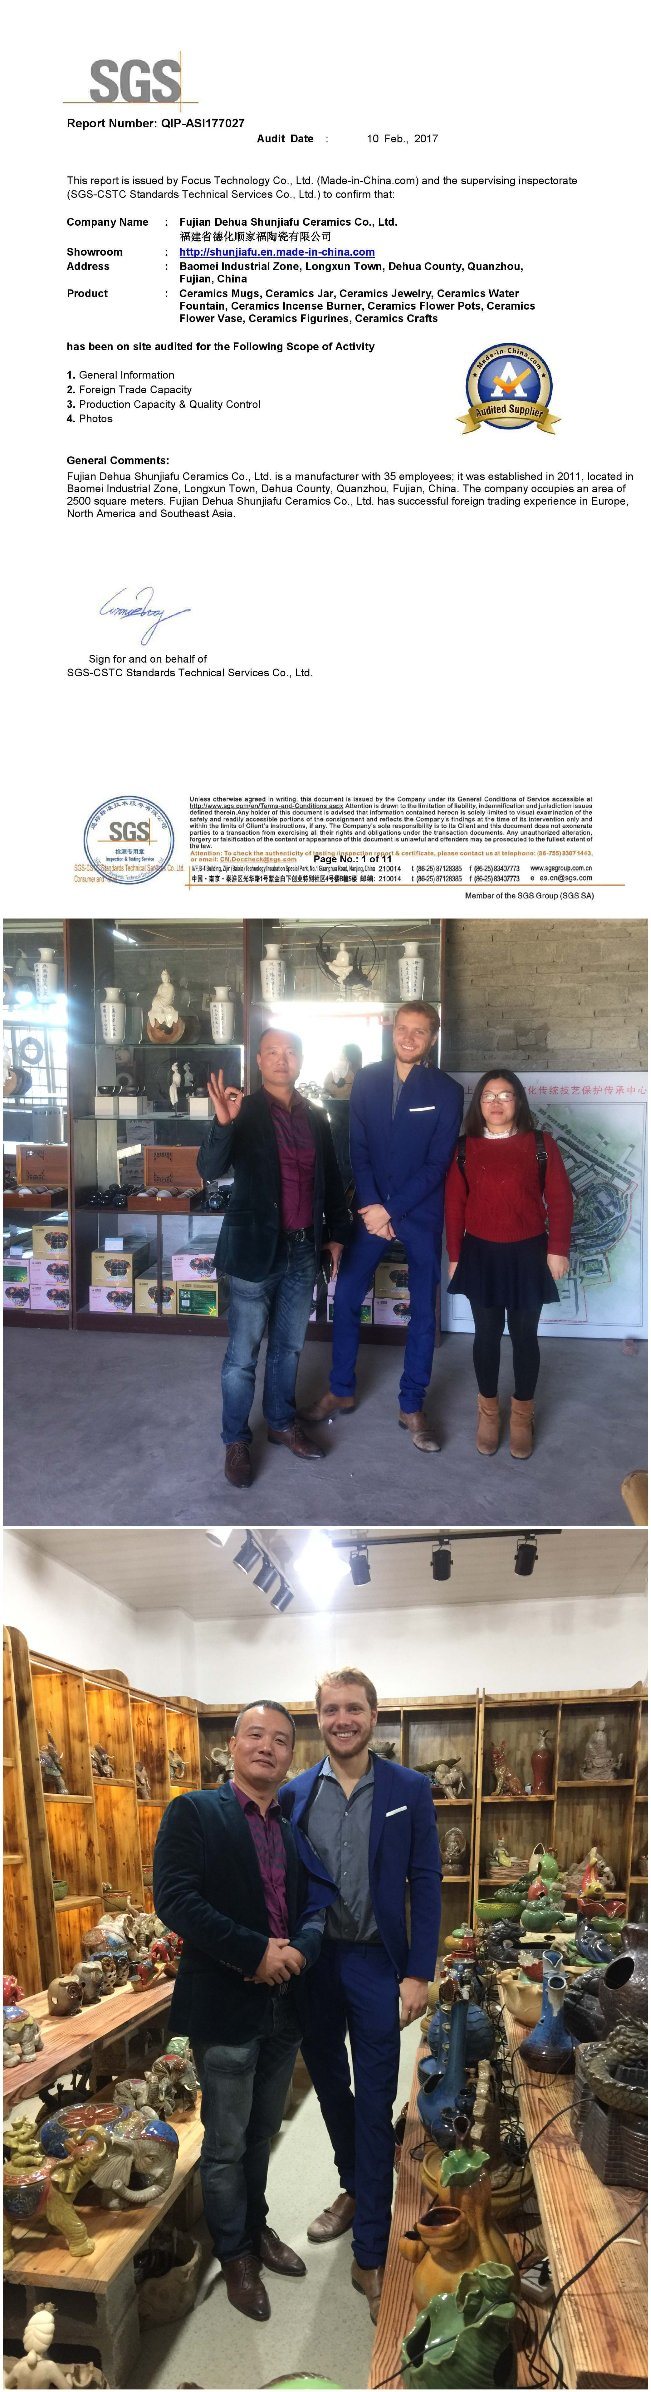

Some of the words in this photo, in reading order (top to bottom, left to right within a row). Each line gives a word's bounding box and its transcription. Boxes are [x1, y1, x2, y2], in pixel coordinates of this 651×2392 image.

[90, 59, 181, 104] SGS
[68, 119, 105, 130] Report
[109, 119, 156, 127] Number:
[162, 119, 244, 128] QIP-ASI177027
[257, 134, 285, 142] Audit
[291, 134, 313, 142] Date
[368, 134, 378, 142] 10
[385, 134, 408, 144] Feb.,
[415, 134, 438, 142] 2017
[67, 176, 87, 184] This
[91, 177, 119, 186] report
[122, 176, 129, 184] is
[133, 176, 163, 184] issued
[167, 176, 178, 186] by
[182, 176, 211, 184] Focus
[214, 176, 269, 186] Technology
[273, 176, 292, 185] Co.,
[297, 176, 313, 184] Ltd.
[317, 176, 418, 186] (Made-in-China.com)
[422, 176, 439, 184] and
[443, 176, 457, 184] the
[461, 176, 515, 186] supervising
[519, 176, 577, 186] inspectorate
[67, 190, 126, 200] (SGS-CSTC
[130, 190, 179, 198] Standards
[182, 190, 228, 198] Technical
[232, 190, 272, 198] Services
[276, 190, 295, 199] Co.,
[300, 190, 320, 200] Ltd.)
[336, 190, 370, 198] confirm
[374, 190, 394, 198] that:
[67, 218, 116, 228] Company
[120, 218, 148, 226] Name
[180, 218, 210, 228] Fujian
[215, 218, 247, 226] Dehua
[251, 218, 299, 228] Shunjiafu
[303, 218, 351, 226] Ceramics
[355, 218, 374, 227] Co.,
[379, 218, 397, 226] Ltd.
[180, 231, 331, 242] 福建省德化顺家福陶瓷有限公司
[67, 248, 122, 256] Showroom
[180, 248, 375, 258] http://shunjiafu.en.made-in-china.com
[67, 262, 109, 270] Address
[180, 262, 218, 270] Baomei
[222, 262, 269, 270] Industrial
[273, 262, 302, 272] Zone,
[306, 262, 350, 272] Longxun
[354, 262, 385, 272] Town,
[389, 262, 421, 270] Dehua
[425, 262, 464, 272] County,
[468, 262, 523, 272] Quanzhou,
[180, 275, 214, 285] Fujian,
[217, 275, 247, 283] China
[67, 289, 108, 297] Product
[180, 289, 228, 297] Ceramics
[232, 289, 262, 299] Mugs,
[266, 289, 314, 297] Ceramics
[318, 289, 336, 299] Jar,
[340, 289, 388, 297] Ceramics
[392, 289, 433, 299] Jewelry,
[437, 289, 485, 297] Ceramics
[489, 289, 519, 297] Water
[180, 302, 227, 311] Fountain,
[231, 302, 279, 310] Ceramics
[283, 302, 323, 310] Incense
[327, 302, 364, 311] Burner,
[368, 302, 416, 310] Ceramics
[420, 302, 455, 310] Flower
[458, 302, 483, 311] Pots,
[487, 302, 535, 310] Ceramics
[180, 314, 215, 322] Flower
[218, 314, 245, 324] Vase,
[249, 314, 297, 322] Ceramics
[301, 314, 351, 324] Figurines,
[355, 314, 403, 322] Ceramics
[407, 314, 438, 322] Crafts
[67, 342, 85, 350] has
[89, 342, 113, 350] been
[133, 342, 151, 350] site
[155, 342, 192, 350] audited
[196, 342, 211, 350] for
[214, 342, 230, 350] the
[234, 342, 282, 352] Following
[287, 342, 319, 353] Scope
[322, 342, 333, 350] of
[336, 342, 375, 352] Activity
[67, 371, 75, 379] 1.
[80, 371, 117, 379] General
[121, 371, 174, 379] Information
[67, 385, 75, 393] 2.
[80, 385, 115, 396] Foreign
[119, 385, 146, 393] Trade
[150, 385, 192, 395] Capacity
[67, 400, 75, 408] 3.
[80, 400, 130, 408] Production
[134, 400, 175, 410] Capacity
[179, 400, 186, 408] &
[190, 400, 223, 410] Quality
[226, 400, 261, 408] Control
[476, 404, 506, 418] Audited
[509, 404, 544, 419] Supplier
[67, 414, 75, 422] 4.
[80, 414, 113, 422] Photos
[67, 456, 106, 464] General
[110, 456, 169, 464] Comments:
[67, 509, 93, 517] North
[97, 509, 135, 517] America
[139, 509, 157, 517] and
[161, 509, 209, 517] Southeast
[212, 509, 235, 517] Asia.
[89, 655, 110, 665] Sign
[113, 655, 126, 663] for
[129, 655, 146, 663] and
[166, 655, 195, 663] behalf
[198, 655, 207, 663] of
[68, 668, 122, 676] SGS-CSTC
[127, 668, 175, 676] Standards
[179, 668, 224, 676] Technical
[273, 669, 291, 678] Co.,
[296, 668, 313, 676] Ltd.
[109, 821, 150, 842] SGS
[314, 855, 337, 865] Page
[340, 855, 359, 863] No.:
[363, 855, 367, 863] 1
[370, 855, 379, 863] of
[382, 855, 391, 863] 11
[536, 892, 558, 900] Group
[560, 892, 580, 900] (SGS
[581, 892, 595, 900] SA)
